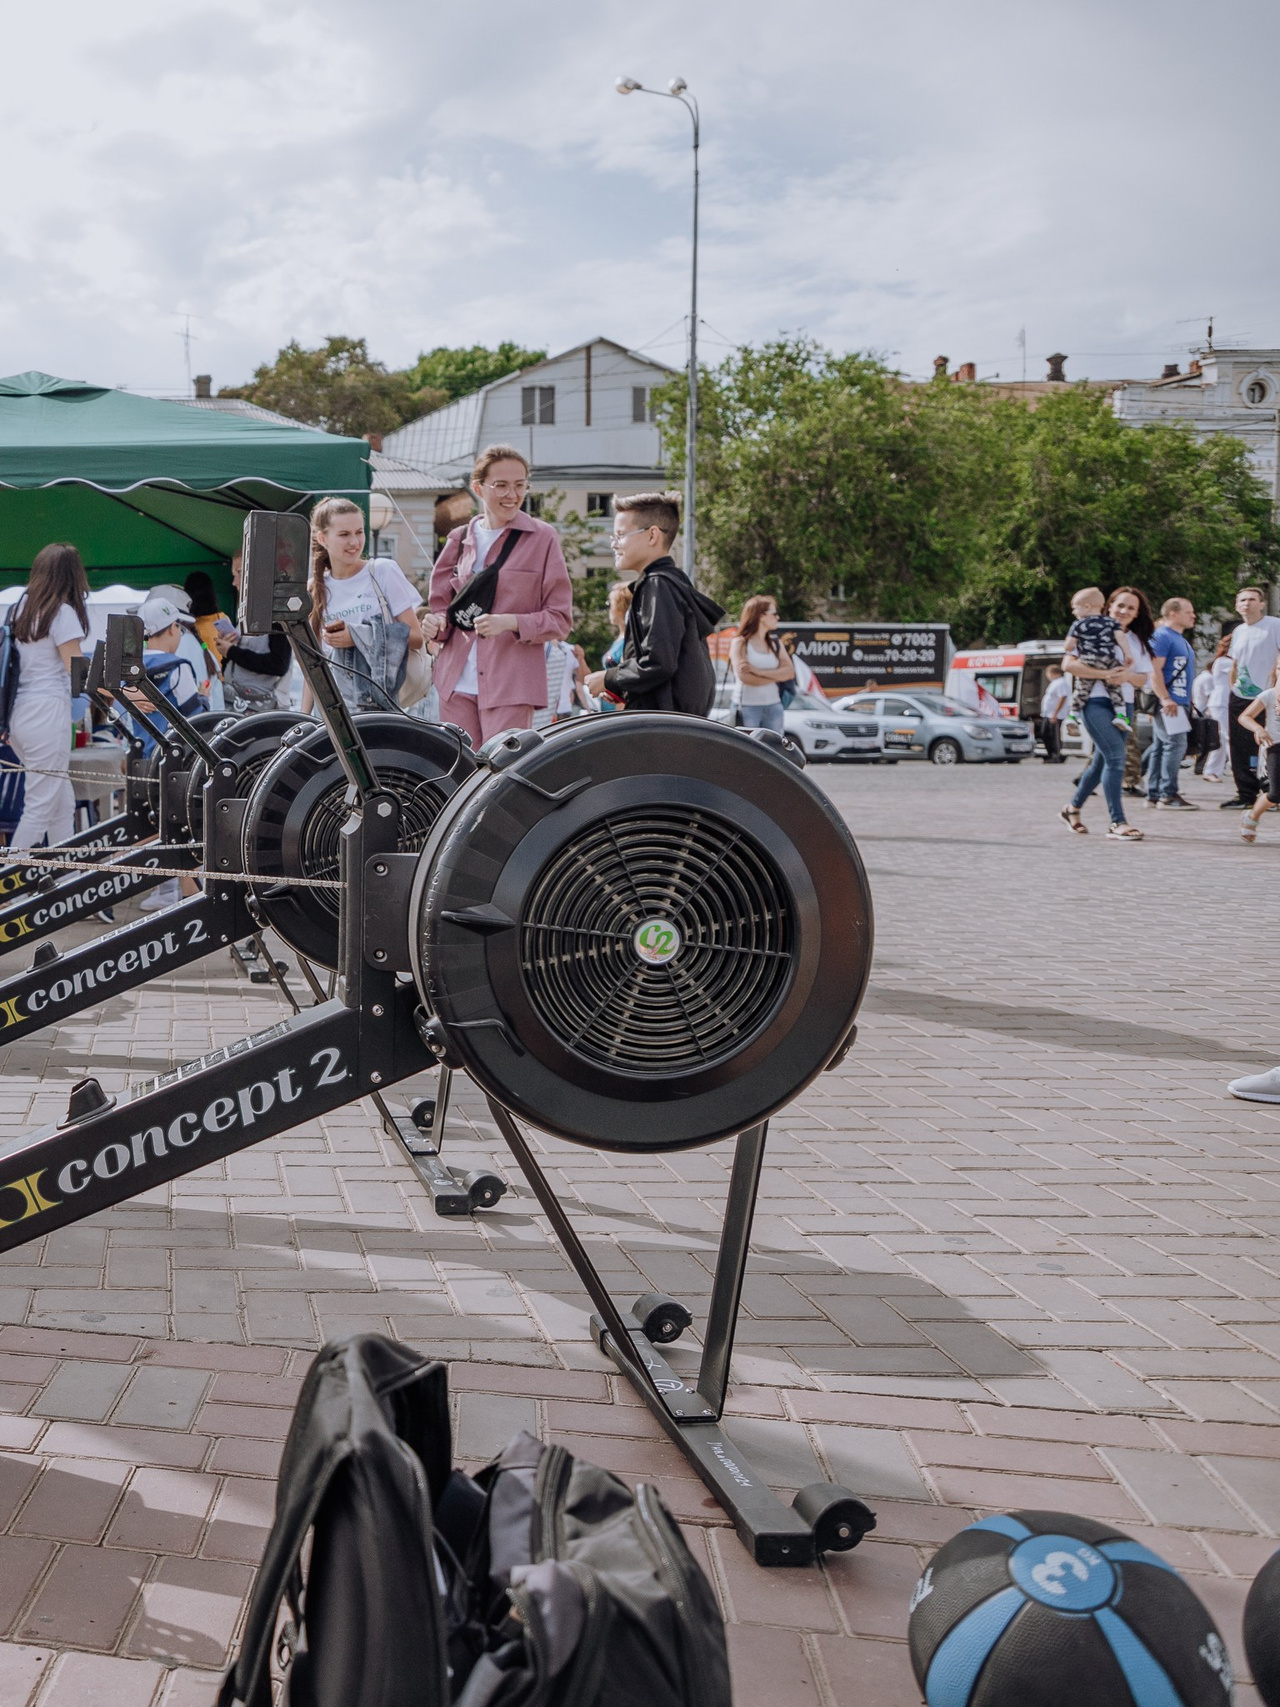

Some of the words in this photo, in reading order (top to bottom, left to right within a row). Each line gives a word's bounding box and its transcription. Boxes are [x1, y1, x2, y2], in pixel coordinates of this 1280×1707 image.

[796, 641, 850, 656] АЛИОТ
[114, 827, 128, 842] 2
[33, 870, 143, 927] concept
[27, 930, 180, 1013] concept
[184, 918, 209, 944] 2
[57, 1064, 303, 1194] concept
[310, 1046, 348, 1089] 2
[1031, 1551, 1089, 1595] 3
